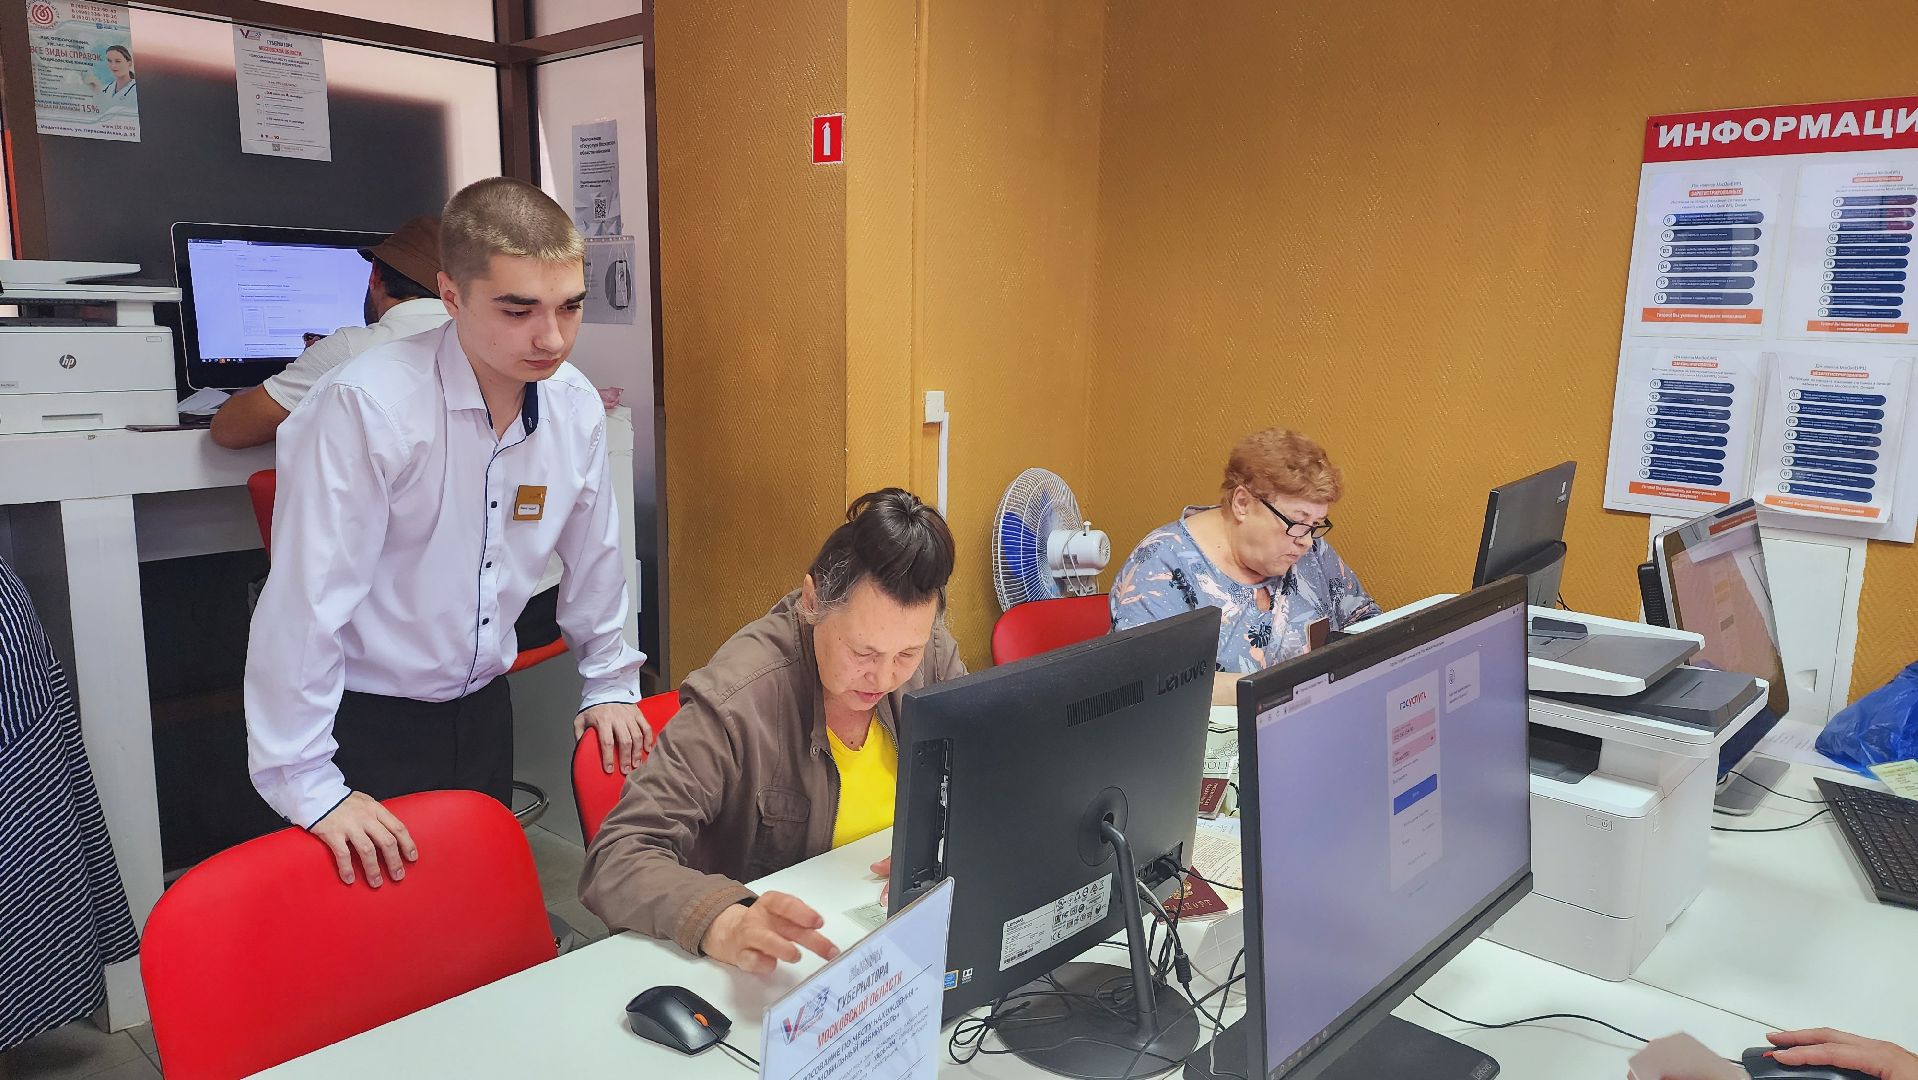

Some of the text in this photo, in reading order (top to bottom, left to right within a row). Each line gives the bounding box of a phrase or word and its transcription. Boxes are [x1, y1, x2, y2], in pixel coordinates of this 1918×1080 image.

[69, 50, 101, 61] СПРАВОК
[82, 104, 100, 113] 15%
[60, 354, 77, 370] hp
[1156, 657, 1207, 696] Lenovo
[1006, 917, 1024, 928] Lenovo
[836, 961, 889, 1012] ГУБЕРНАТОРА
[817, 995, 868, 1048] МОСКОВСКОЙ
[869, 969, 904, 1006] ОБЛАСТИ
[841, 1039, 851, 1052] ПО
[852, 1020, 873, 1042] МЕСТУ
